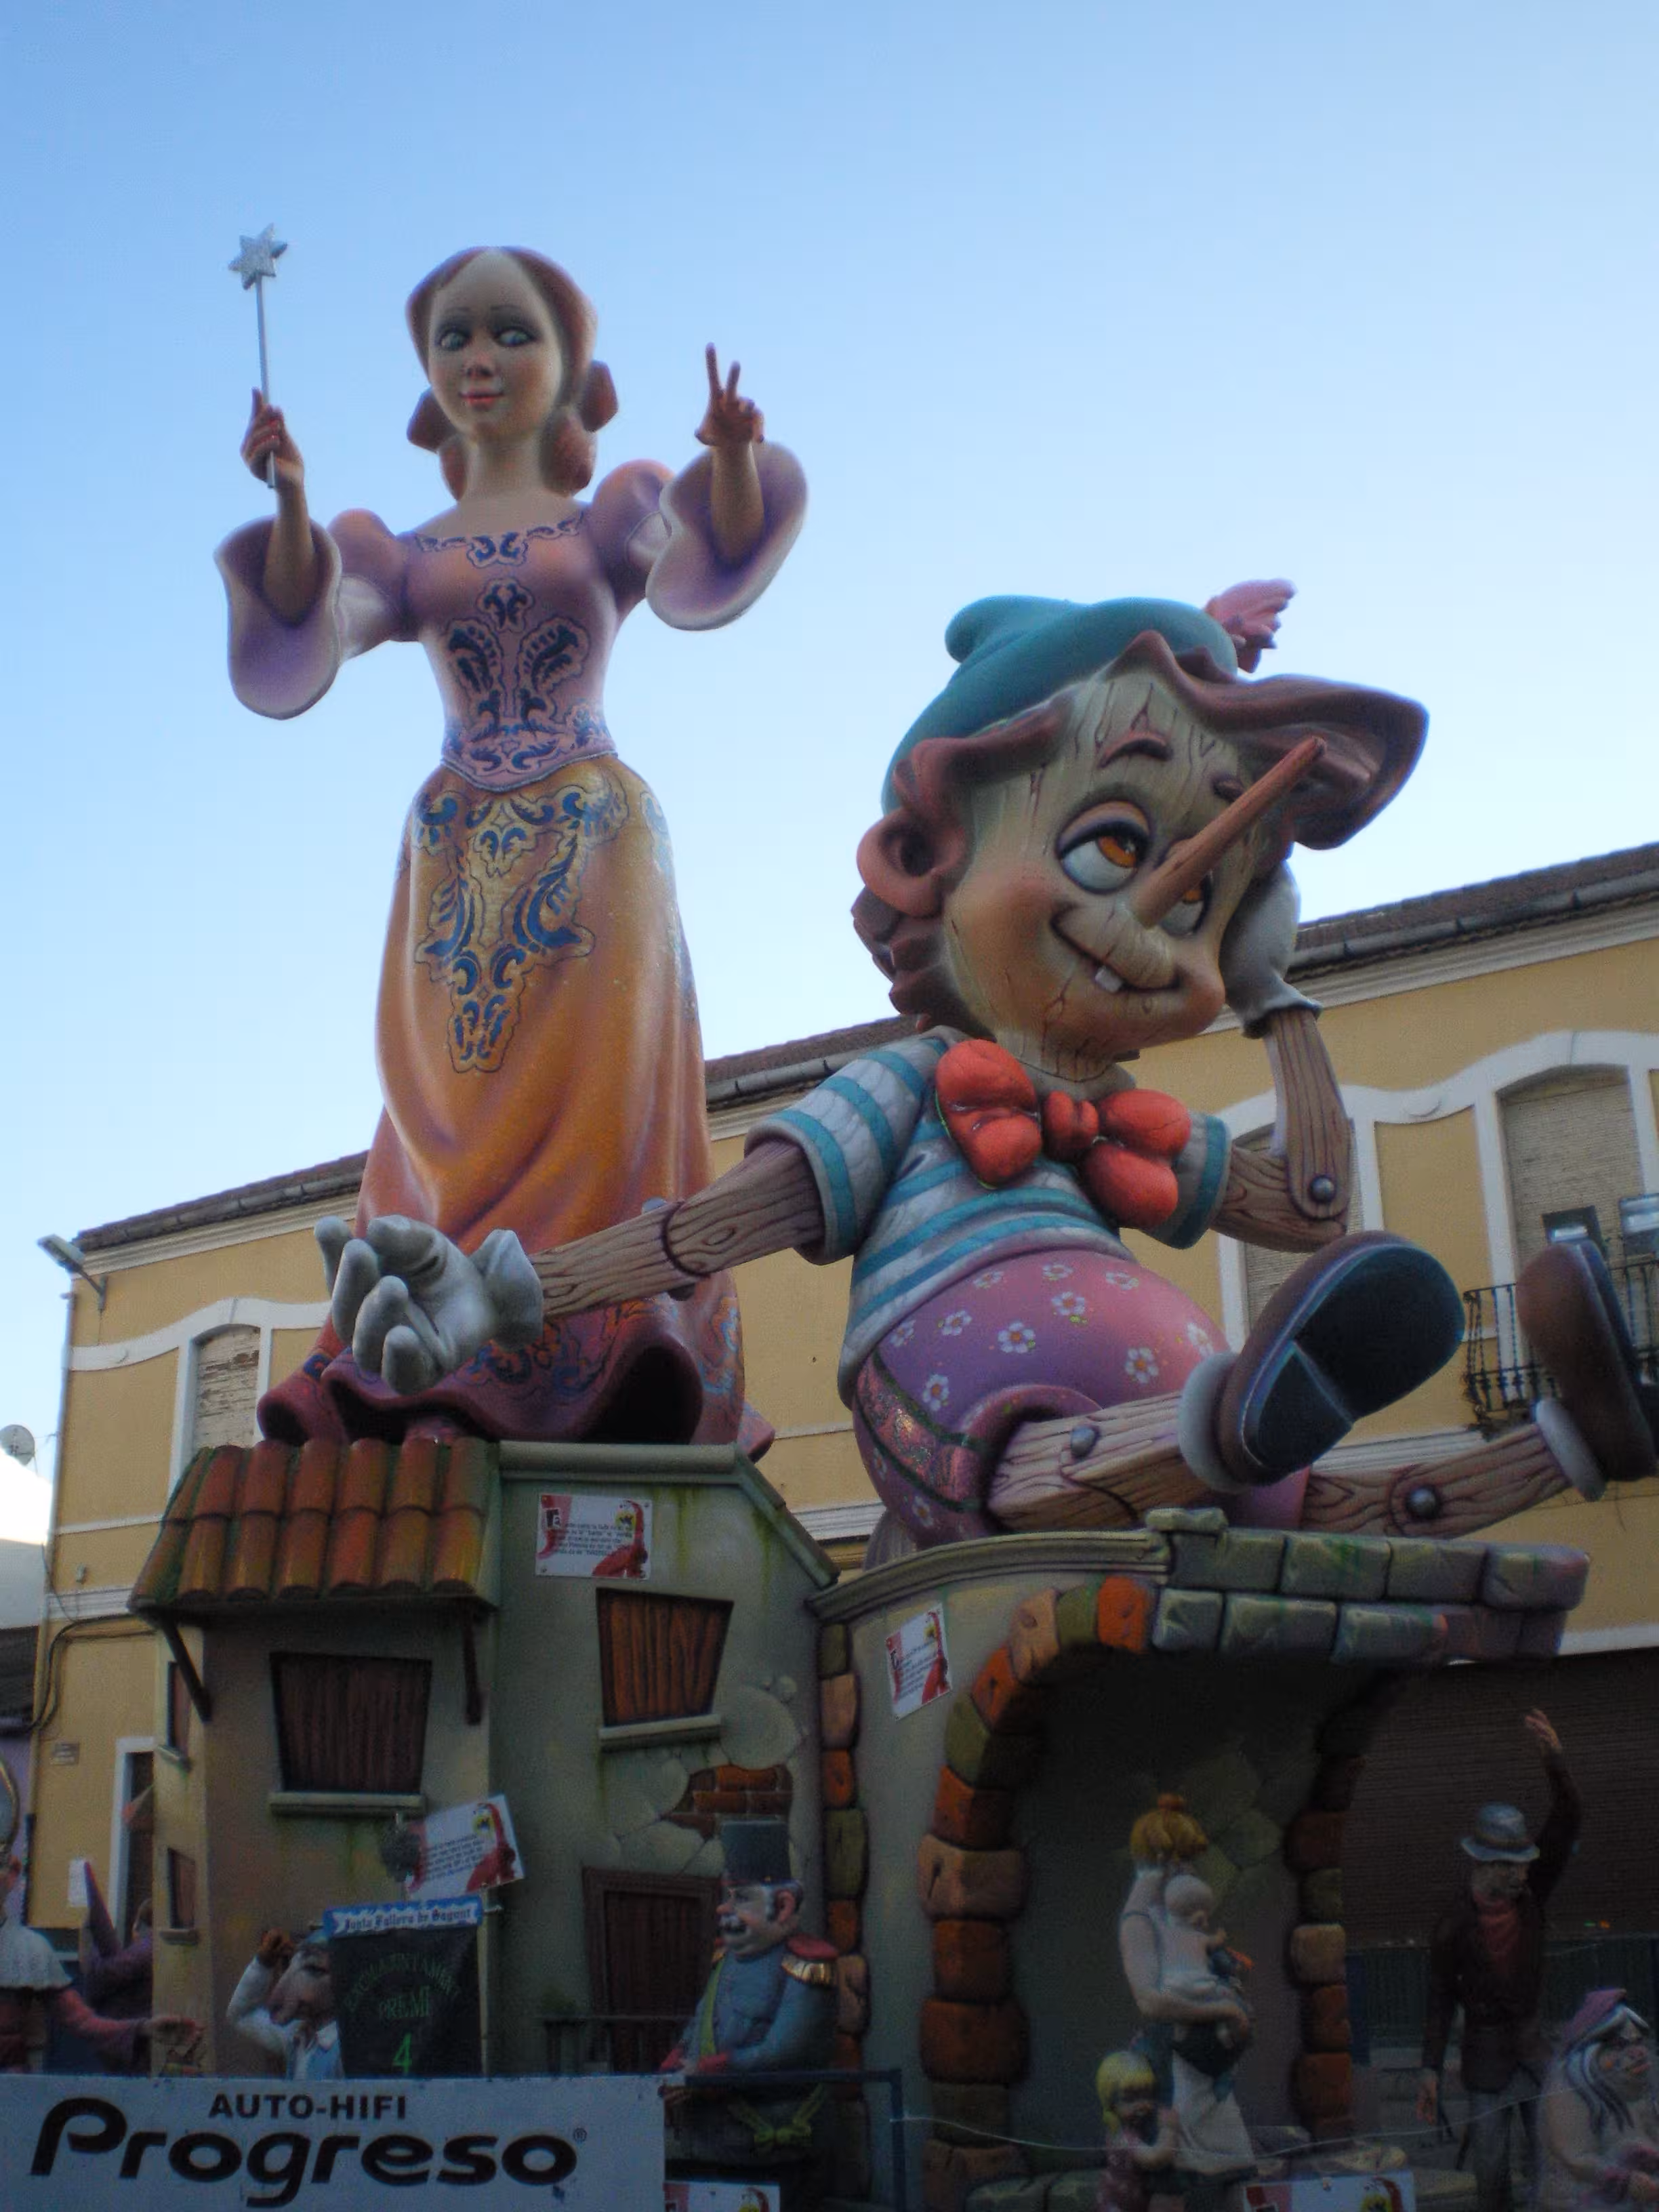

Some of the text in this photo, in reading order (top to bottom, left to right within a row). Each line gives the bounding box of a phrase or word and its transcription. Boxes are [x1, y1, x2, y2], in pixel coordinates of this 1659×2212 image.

[392, 2032, 413, 2074] 4
[209, 2092, 407, 2119] AUTO-HIFI
[30, 2096, 577, 2208] Progreso
